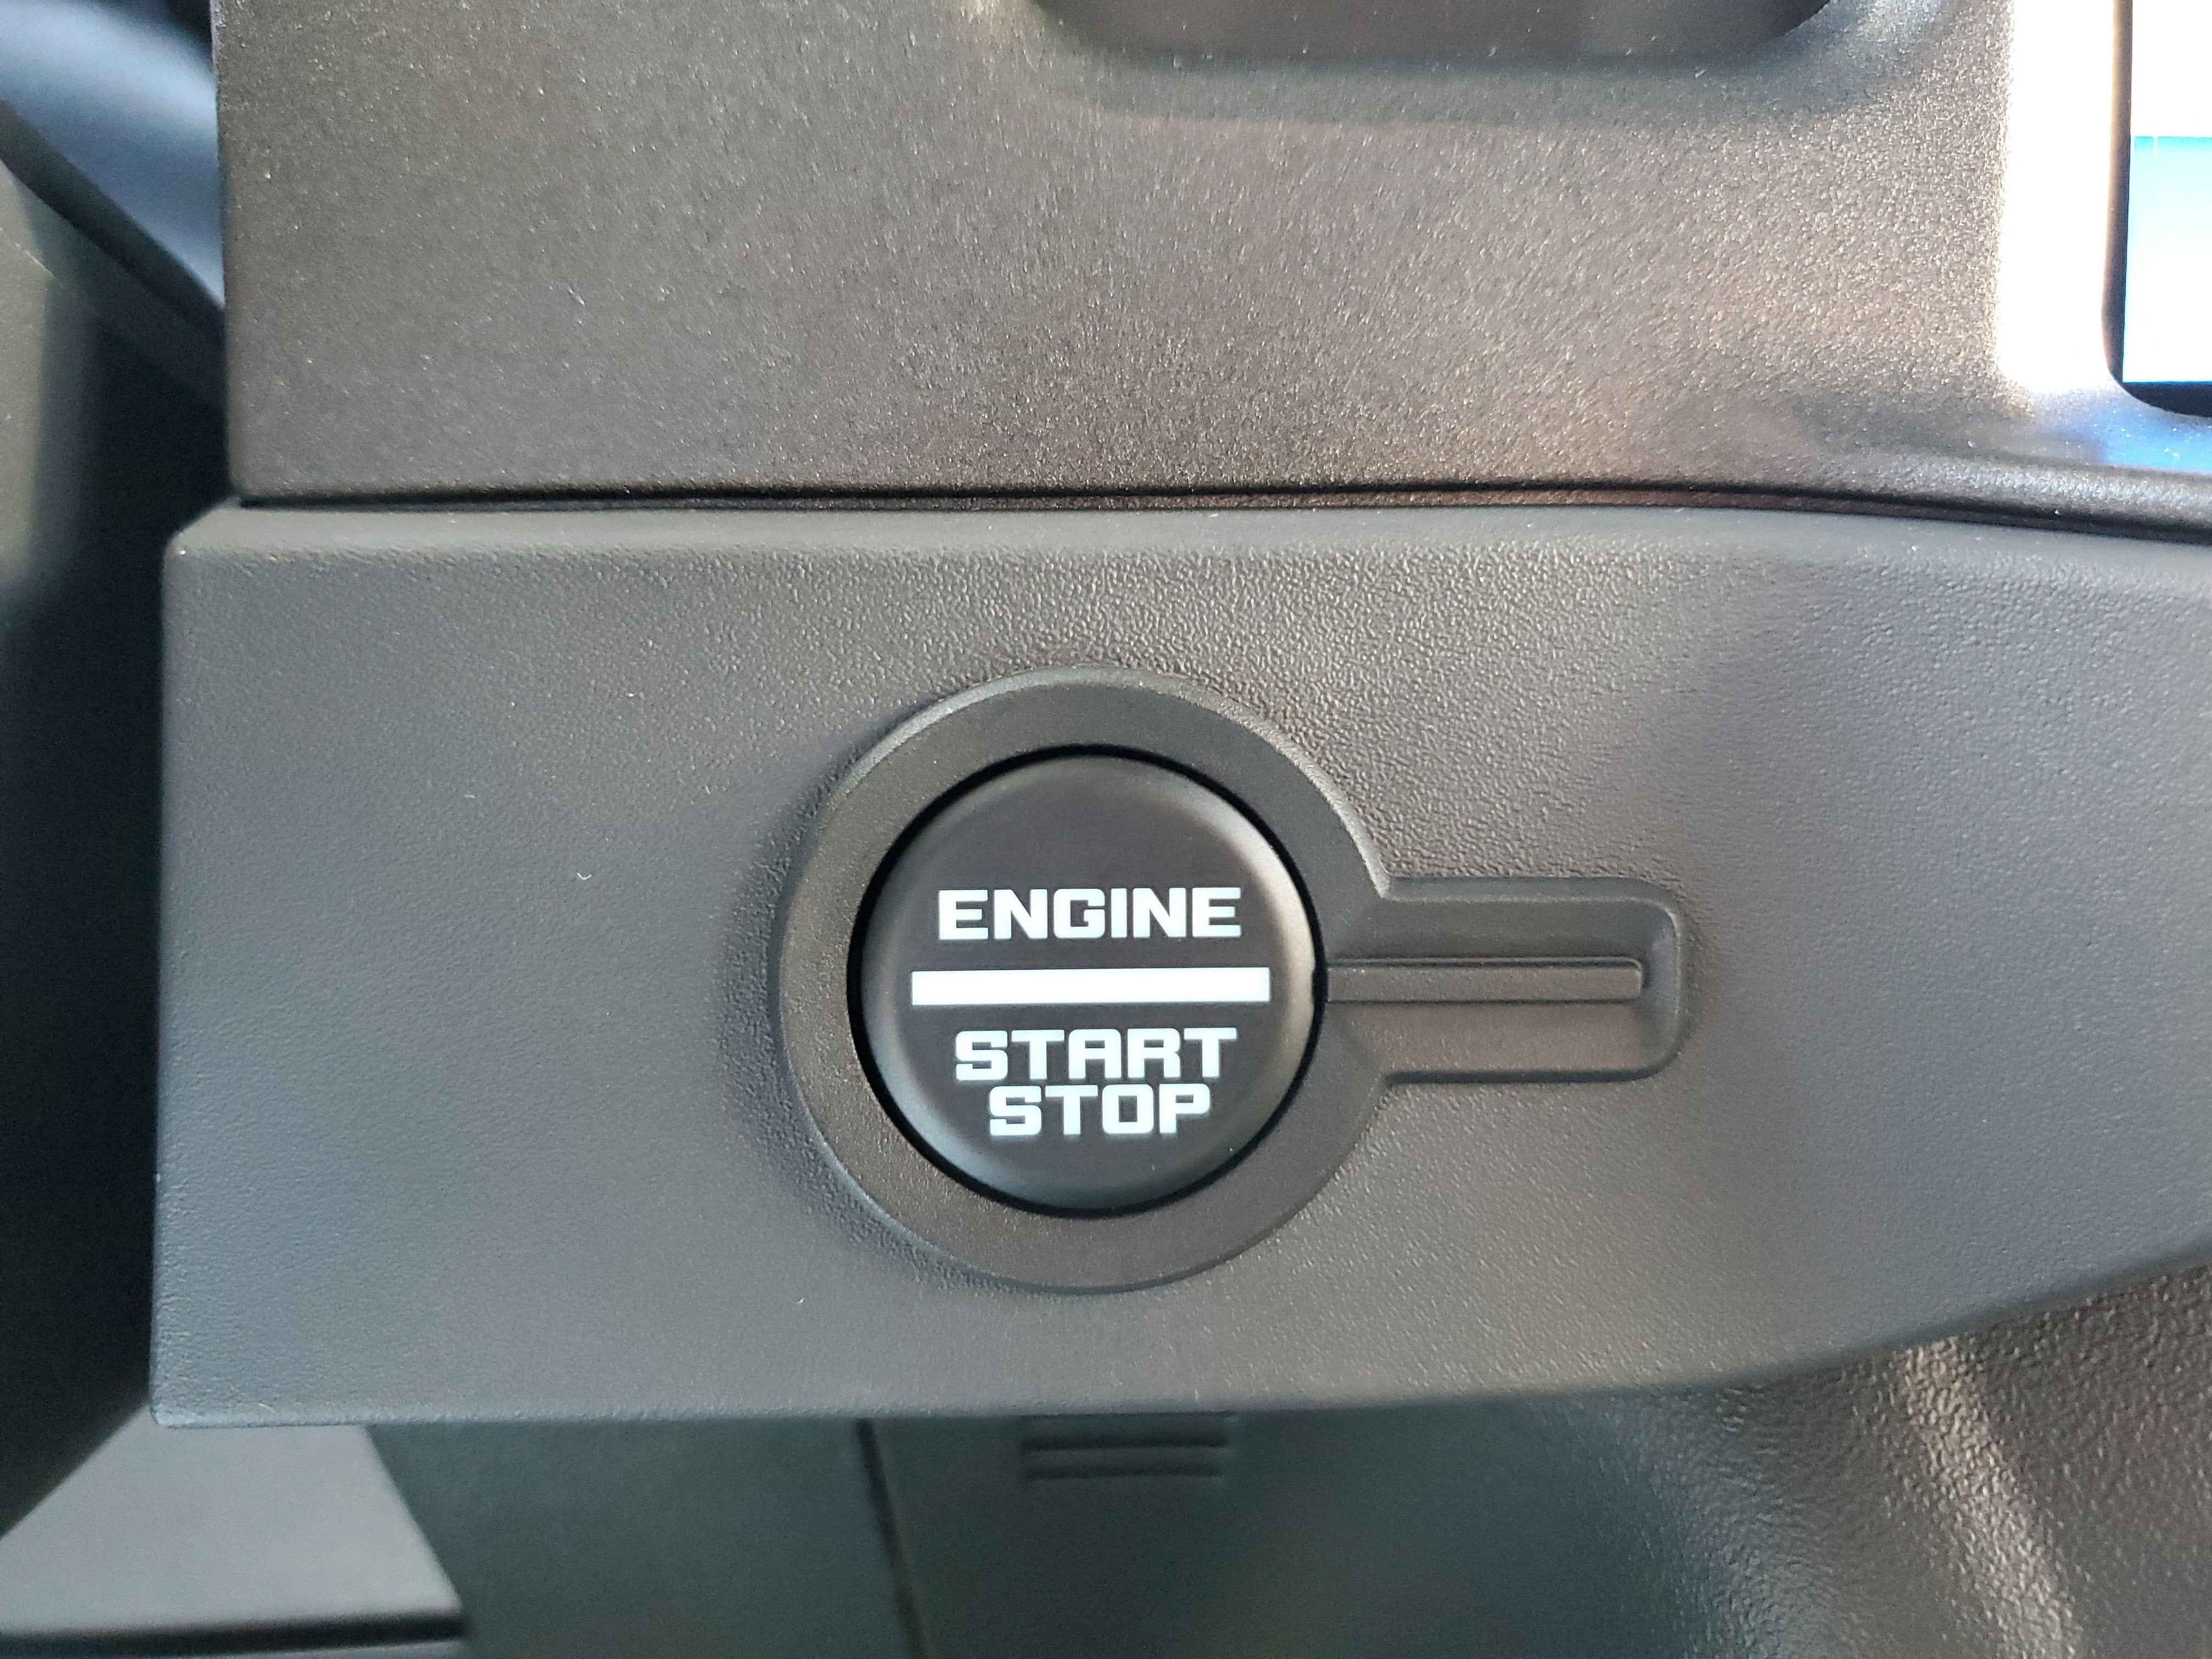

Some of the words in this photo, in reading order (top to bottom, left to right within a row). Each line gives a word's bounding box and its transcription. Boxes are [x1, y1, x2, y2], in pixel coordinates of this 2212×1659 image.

[938, 887, 1242, 941] ENGINE
[955, 1027, 1238, 1082] START
[989, 1083, 1211, 1138] STOP
